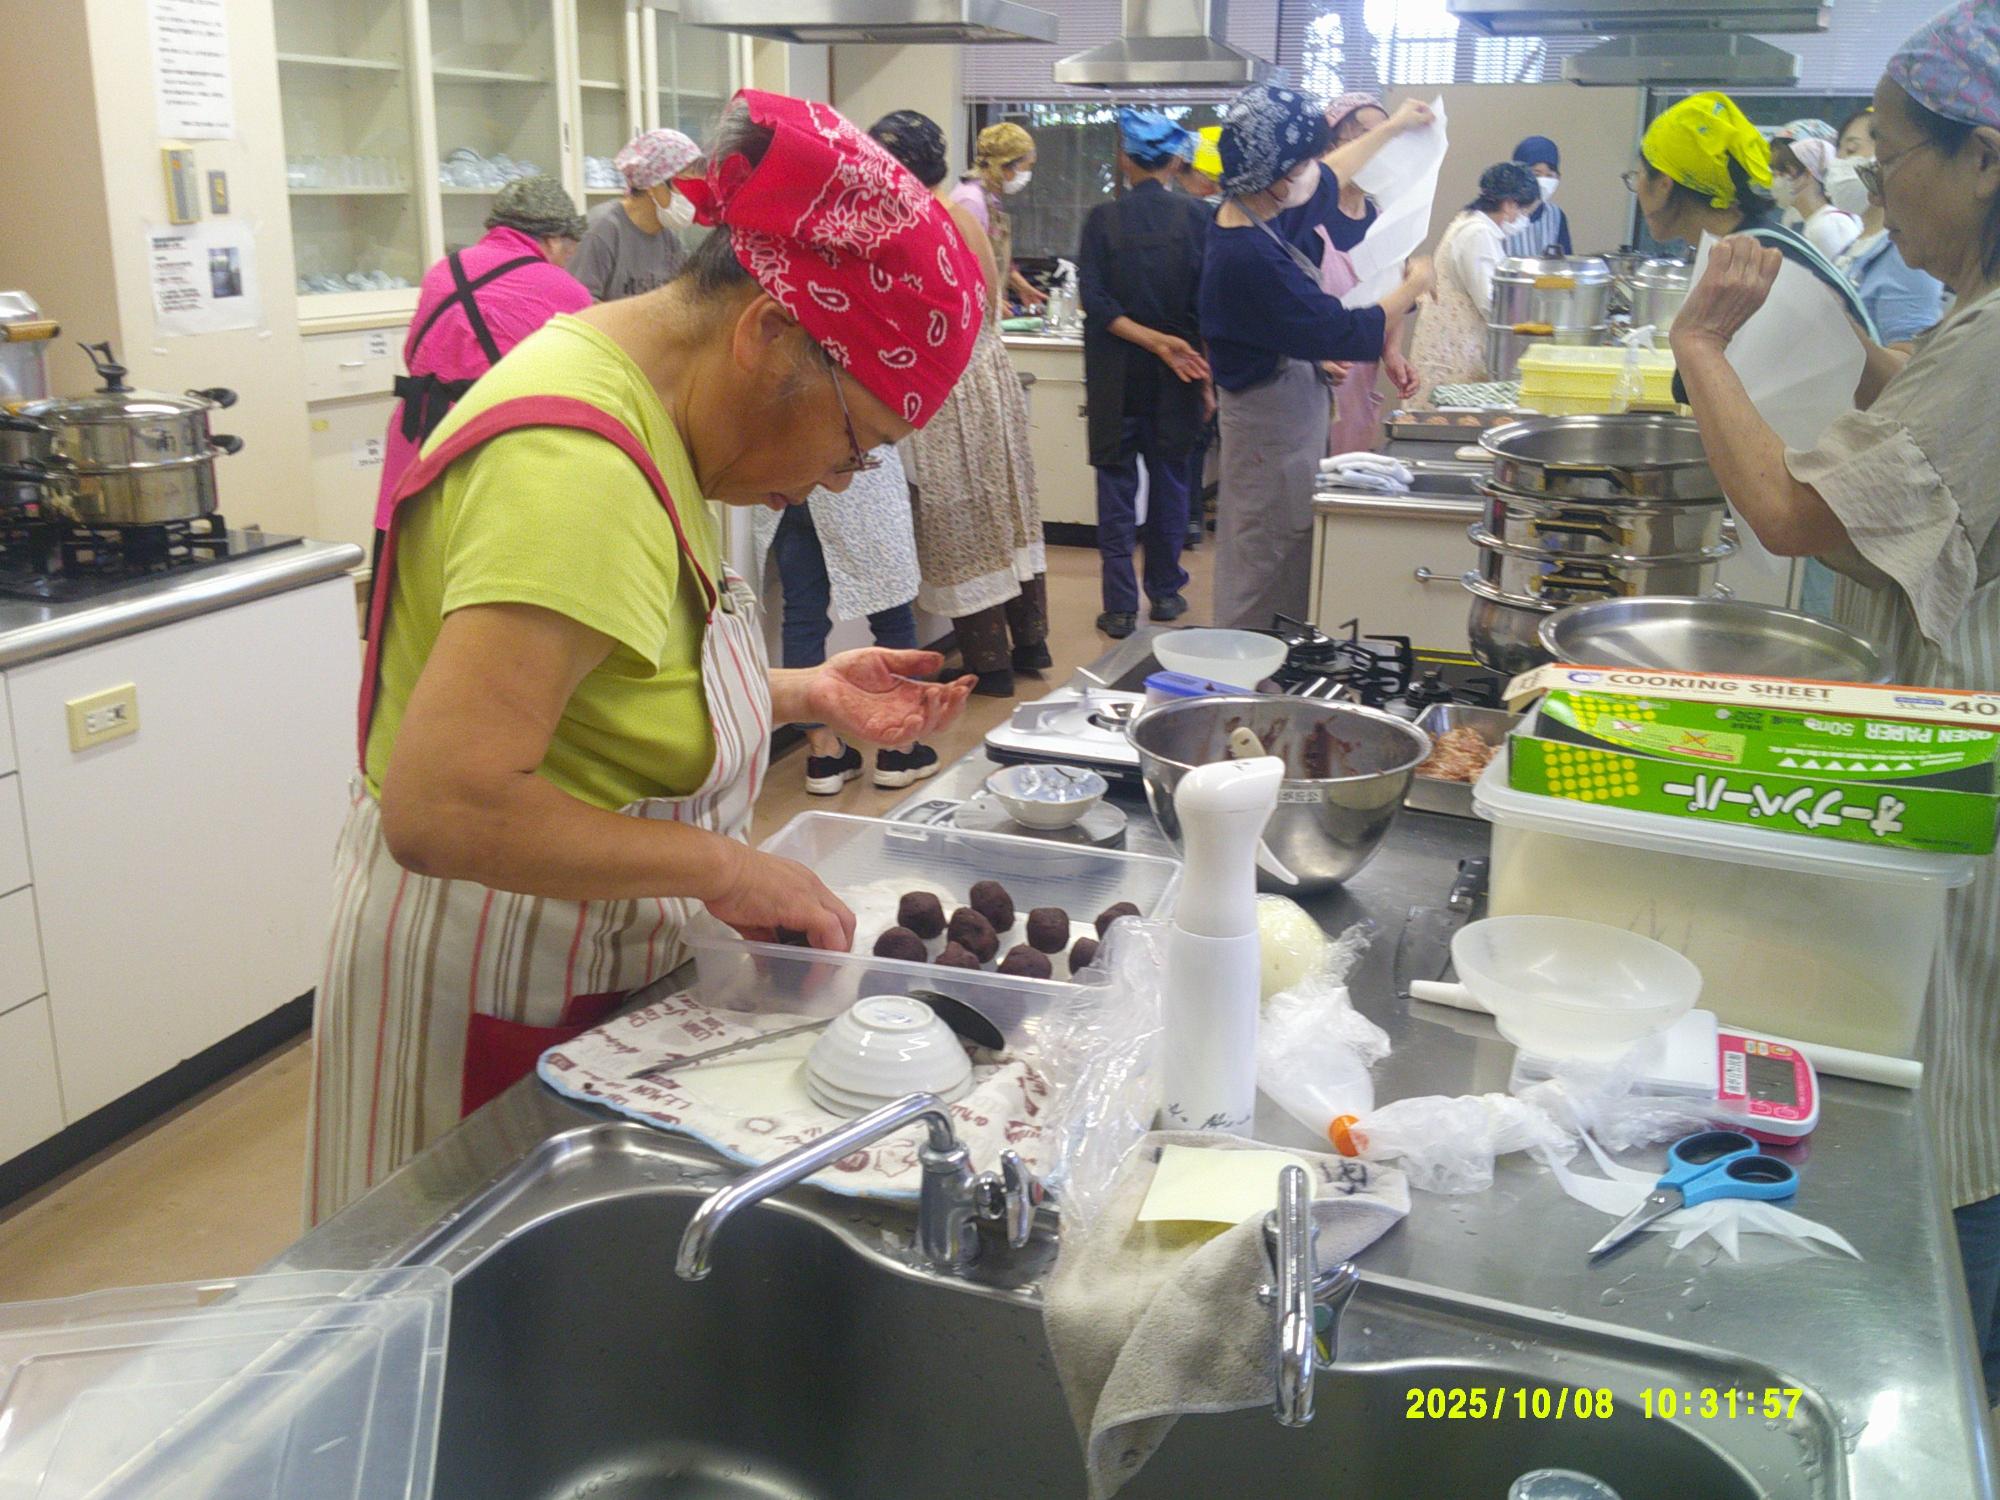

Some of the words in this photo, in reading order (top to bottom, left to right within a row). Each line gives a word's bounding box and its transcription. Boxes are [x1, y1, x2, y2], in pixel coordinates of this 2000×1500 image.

[1608, 673, 1738, 692] COOKING
[1749, 683, 1834, 700] SHEET
[1865, 721, 1934, 745] PAPER
[1662, 773, 1907, 838] オーブンペーパー
